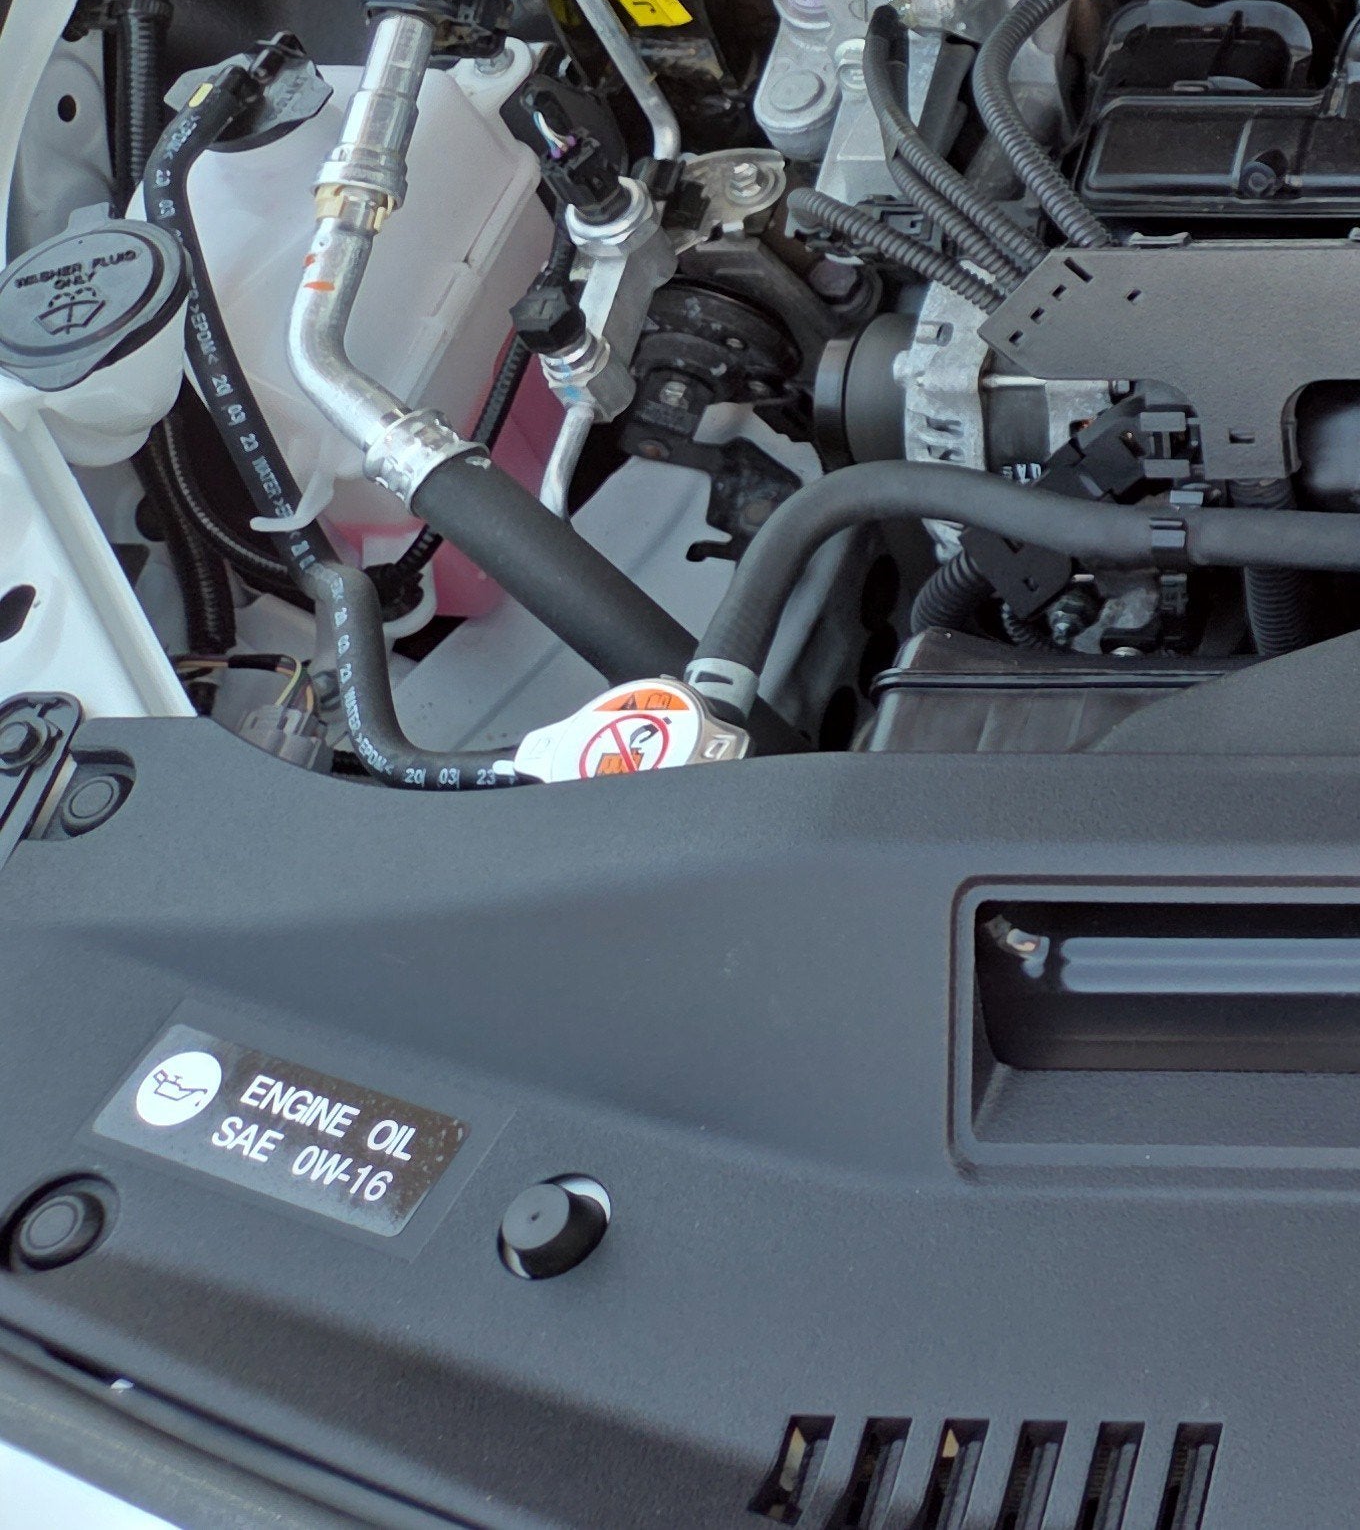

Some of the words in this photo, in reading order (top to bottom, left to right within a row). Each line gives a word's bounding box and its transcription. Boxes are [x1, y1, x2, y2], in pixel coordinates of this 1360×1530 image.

[211, 1116, 284, 1163] SAE
[291, 1145, 394, 1202] 0W-16
[240, 1074, 360, 1138] ENGINE
[366, 1119, 417, 1161] OIL
